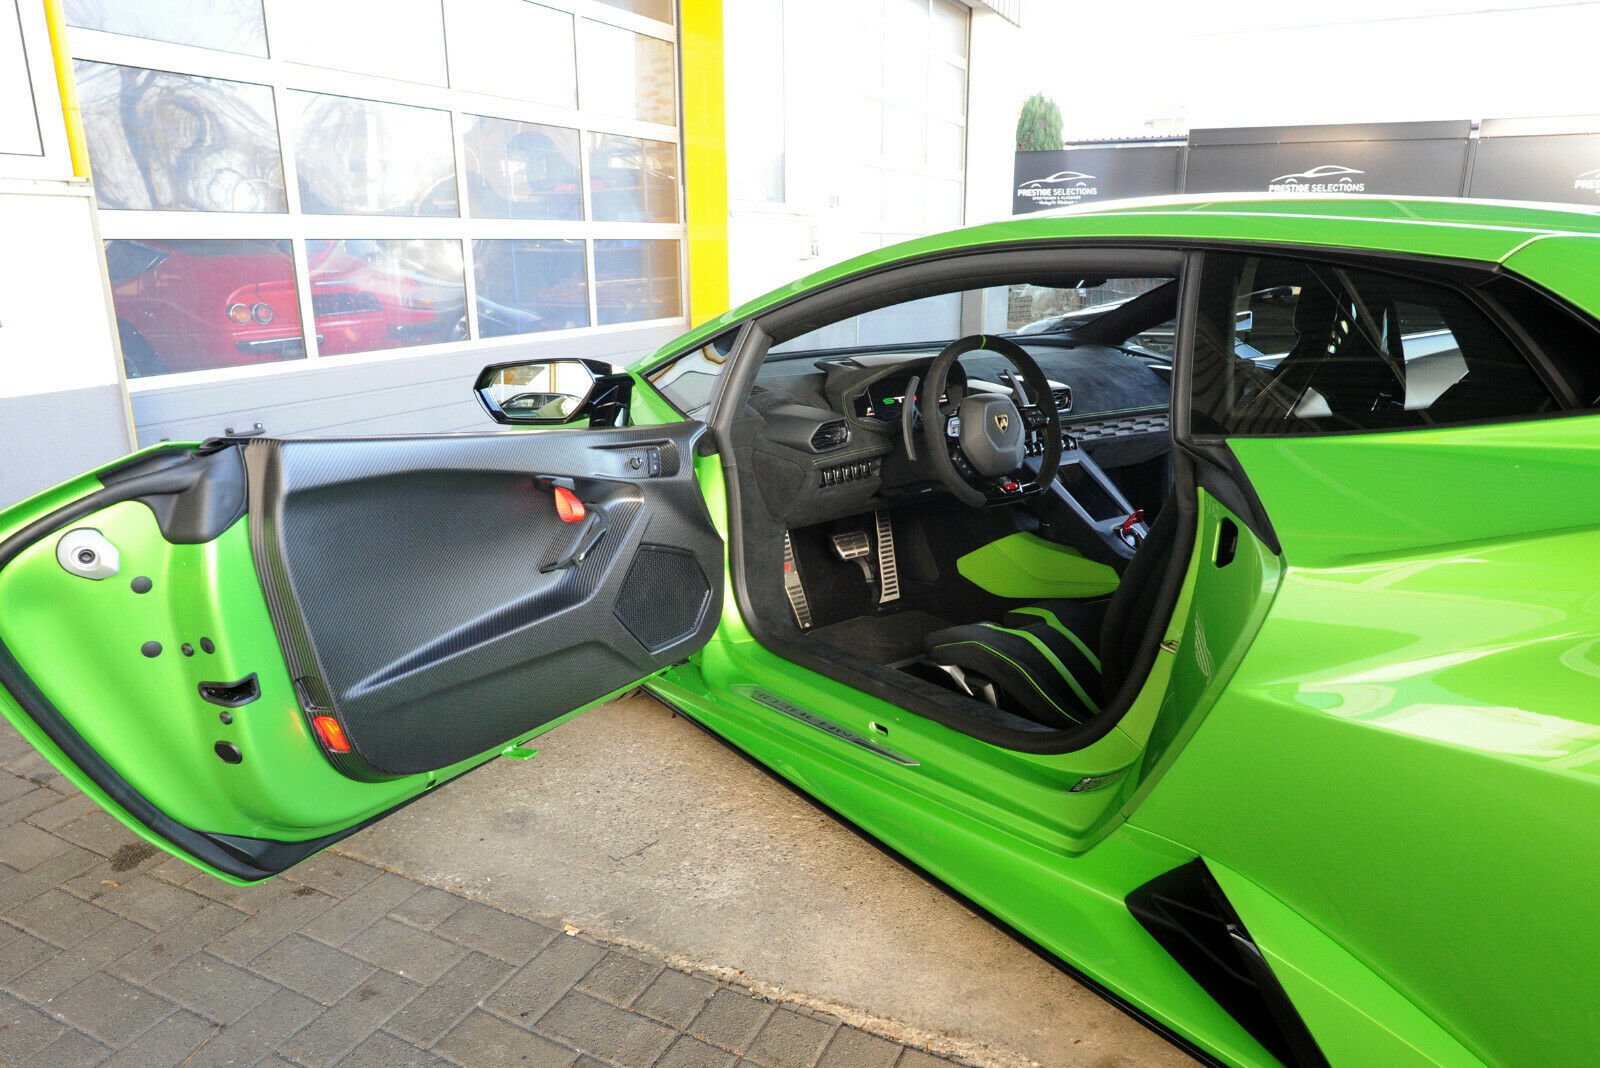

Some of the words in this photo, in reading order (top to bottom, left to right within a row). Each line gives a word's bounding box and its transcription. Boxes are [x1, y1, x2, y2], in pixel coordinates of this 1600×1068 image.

[1017, 188, 1052, 197] PRESTIGE
[1053, 187, 1097, 196] SELECTIONS
[1269, 184, 1310, 192] PRESTIGE
[1311, 183, 1365, 192] SELECTIONS
